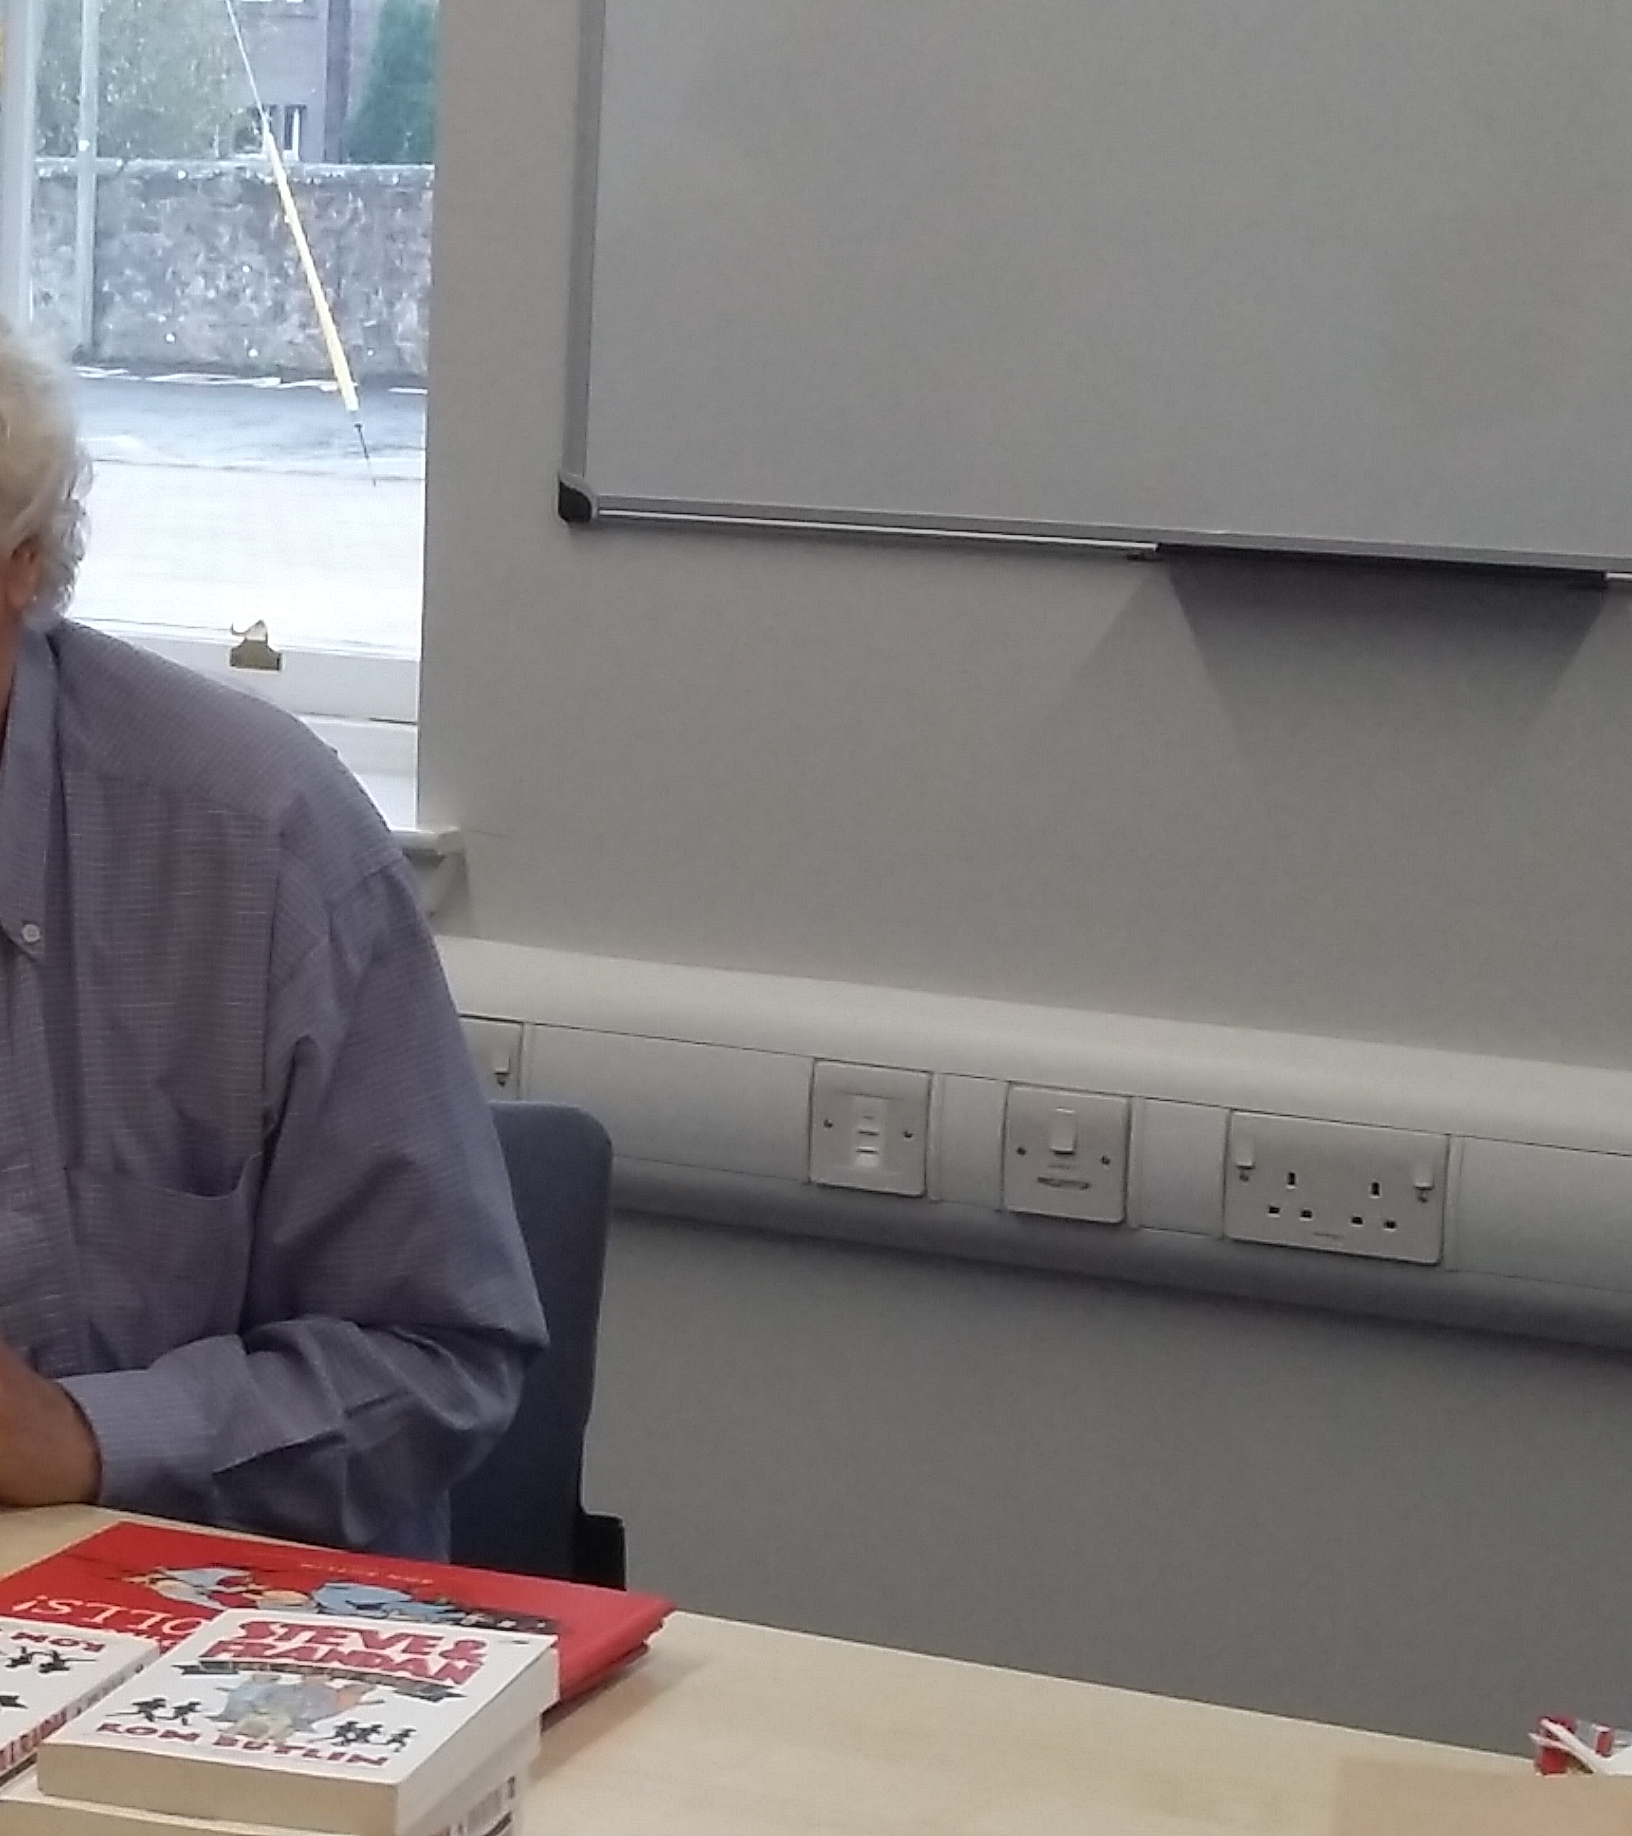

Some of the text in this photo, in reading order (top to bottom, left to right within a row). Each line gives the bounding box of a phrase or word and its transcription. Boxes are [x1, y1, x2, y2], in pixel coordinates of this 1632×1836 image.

[10, 1630, 106, 1653] RON
[200, 1640, 485, 1686] FRANDAN
[239, 1620, 490, 1665] STEVE &
[96, 1721, 390, 1767] RON BUTLIN
